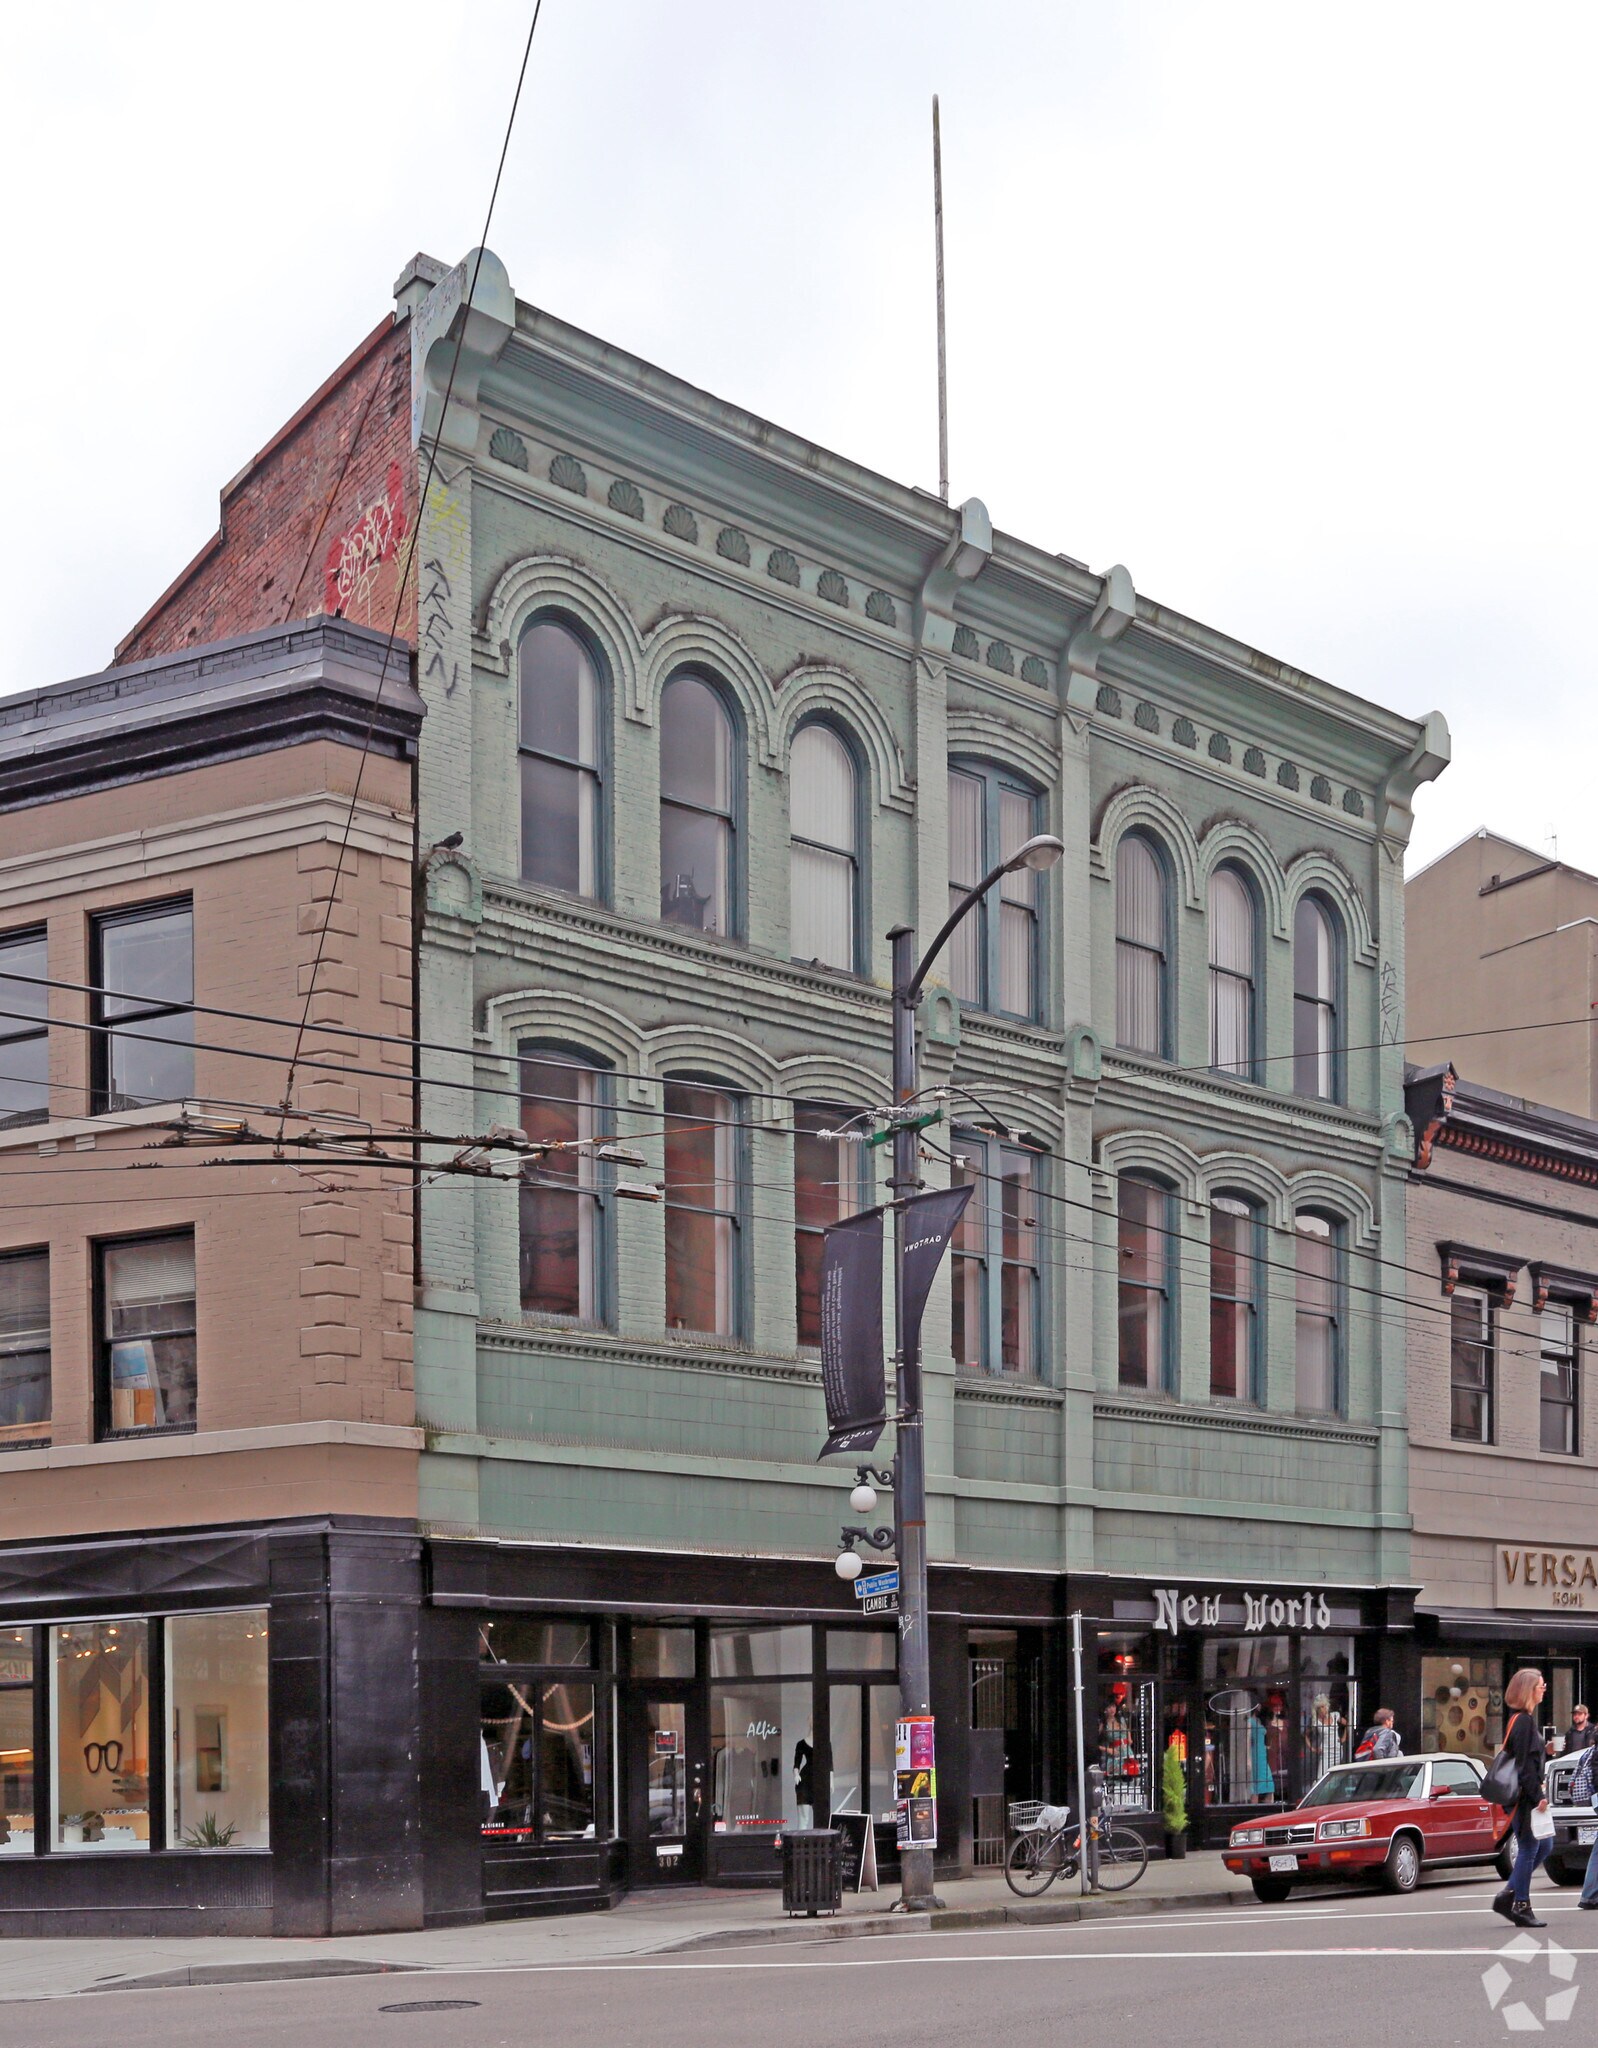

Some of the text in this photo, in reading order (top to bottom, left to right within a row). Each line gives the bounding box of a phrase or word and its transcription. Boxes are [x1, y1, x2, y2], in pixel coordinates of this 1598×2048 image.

[1502, 1550, 1598, 1589] VERSA
[866, 1595, 888, 1612] CAMBIE
[1552, 1591, 1584, 1608] HOME
[1152, 1589, 1222, 1636] New
[746, 1720, 778, 1740] Alfie
[659, 1855, 679, 1867] 302
